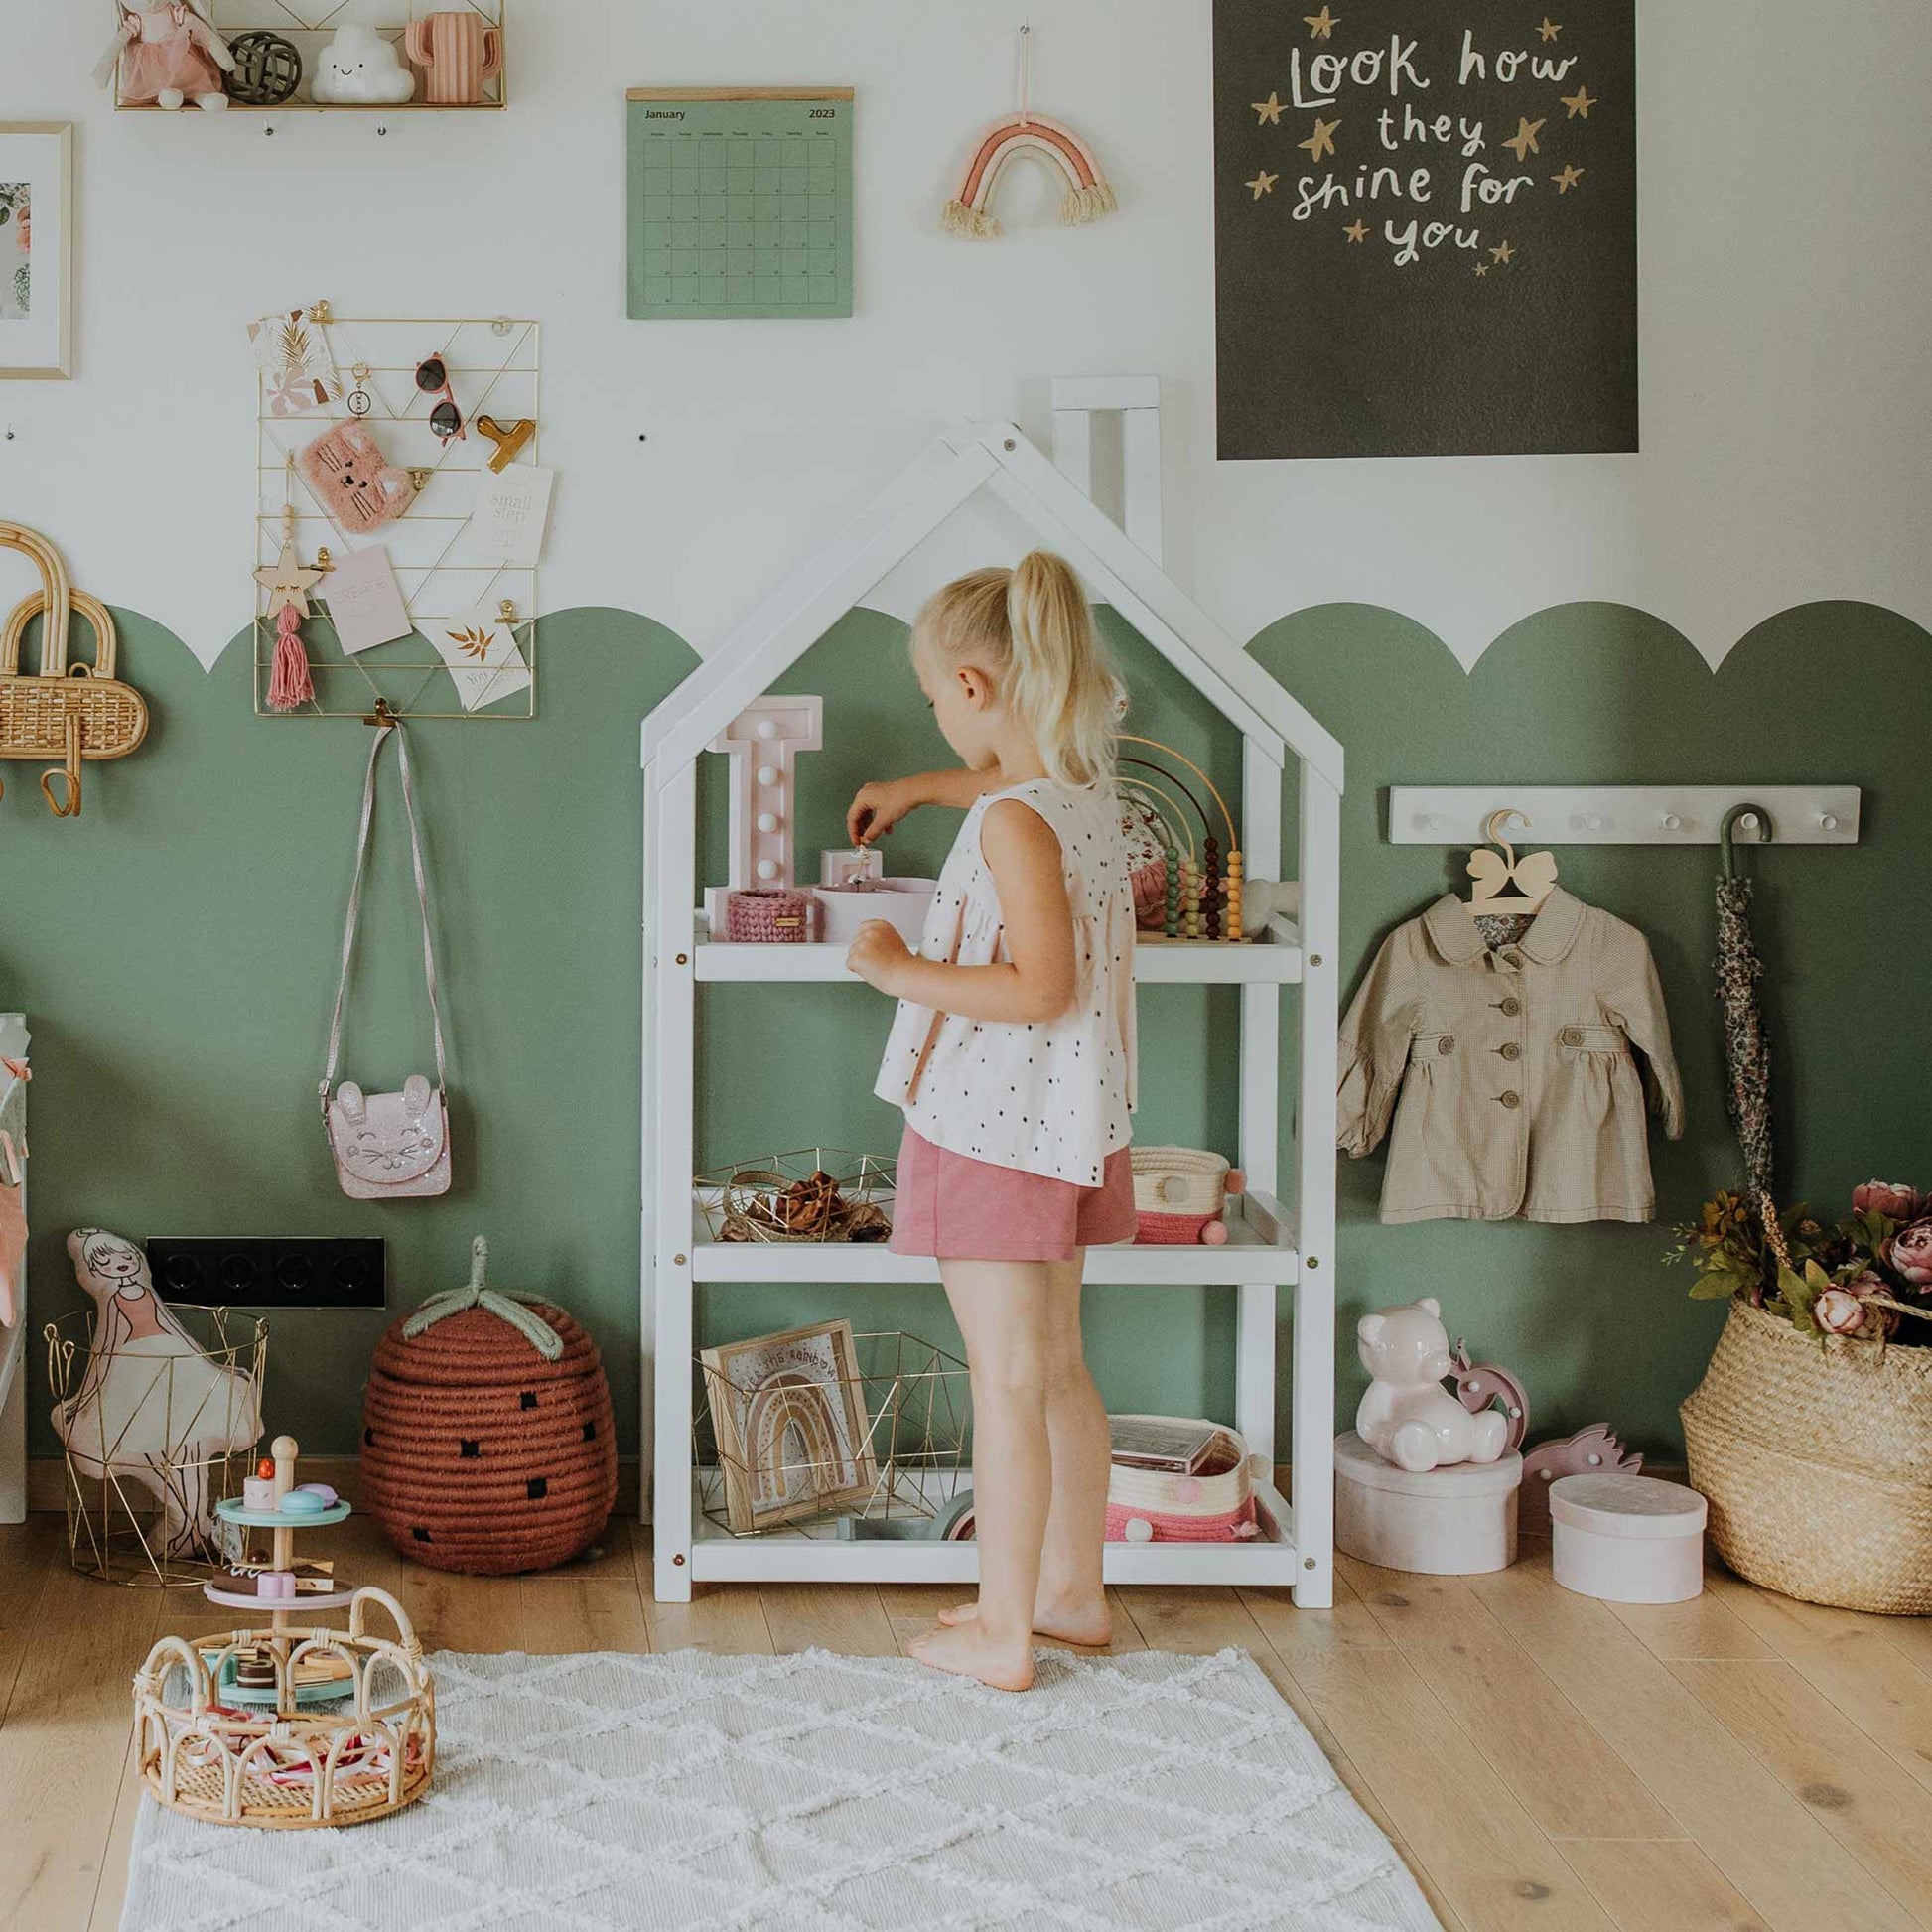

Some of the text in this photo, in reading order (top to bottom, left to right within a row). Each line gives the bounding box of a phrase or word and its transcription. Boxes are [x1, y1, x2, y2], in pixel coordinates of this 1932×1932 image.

[1291, 29, 1578, 108] Look how
[645, 108, 836, 121] January 2023
[1377, 103, 1486, 157] they
[1292, 162, 1535, 221] shine for
[1384, 219, 1480, 267] you
[490, 492, 533, 510] small
